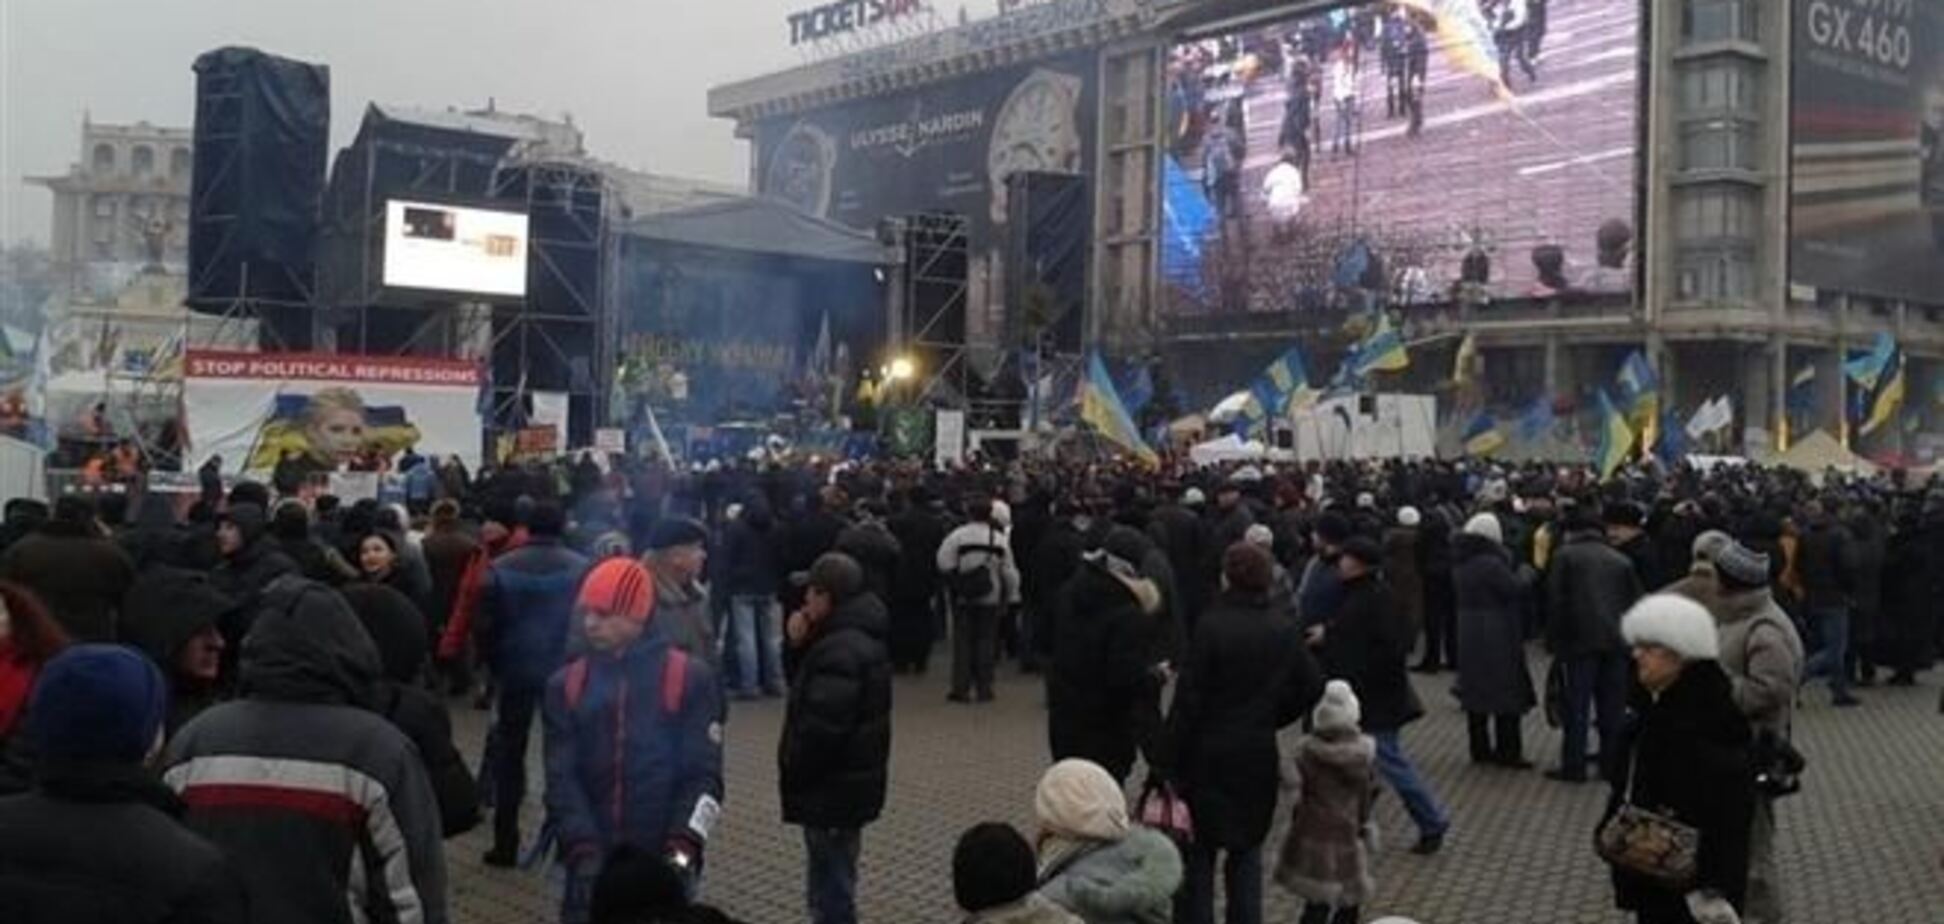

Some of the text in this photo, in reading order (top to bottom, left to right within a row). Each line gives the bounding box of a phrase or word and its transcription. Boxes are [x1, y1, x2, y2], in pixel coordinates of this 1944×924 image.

[1808, 2, 1911, 68] GX 460
[850, 123, 909, 150] ULYSSE
[917, 110, 983, 134] NARDIN
[191, 360, 479, 382] STOP POLITICAL REPRESSIONS
